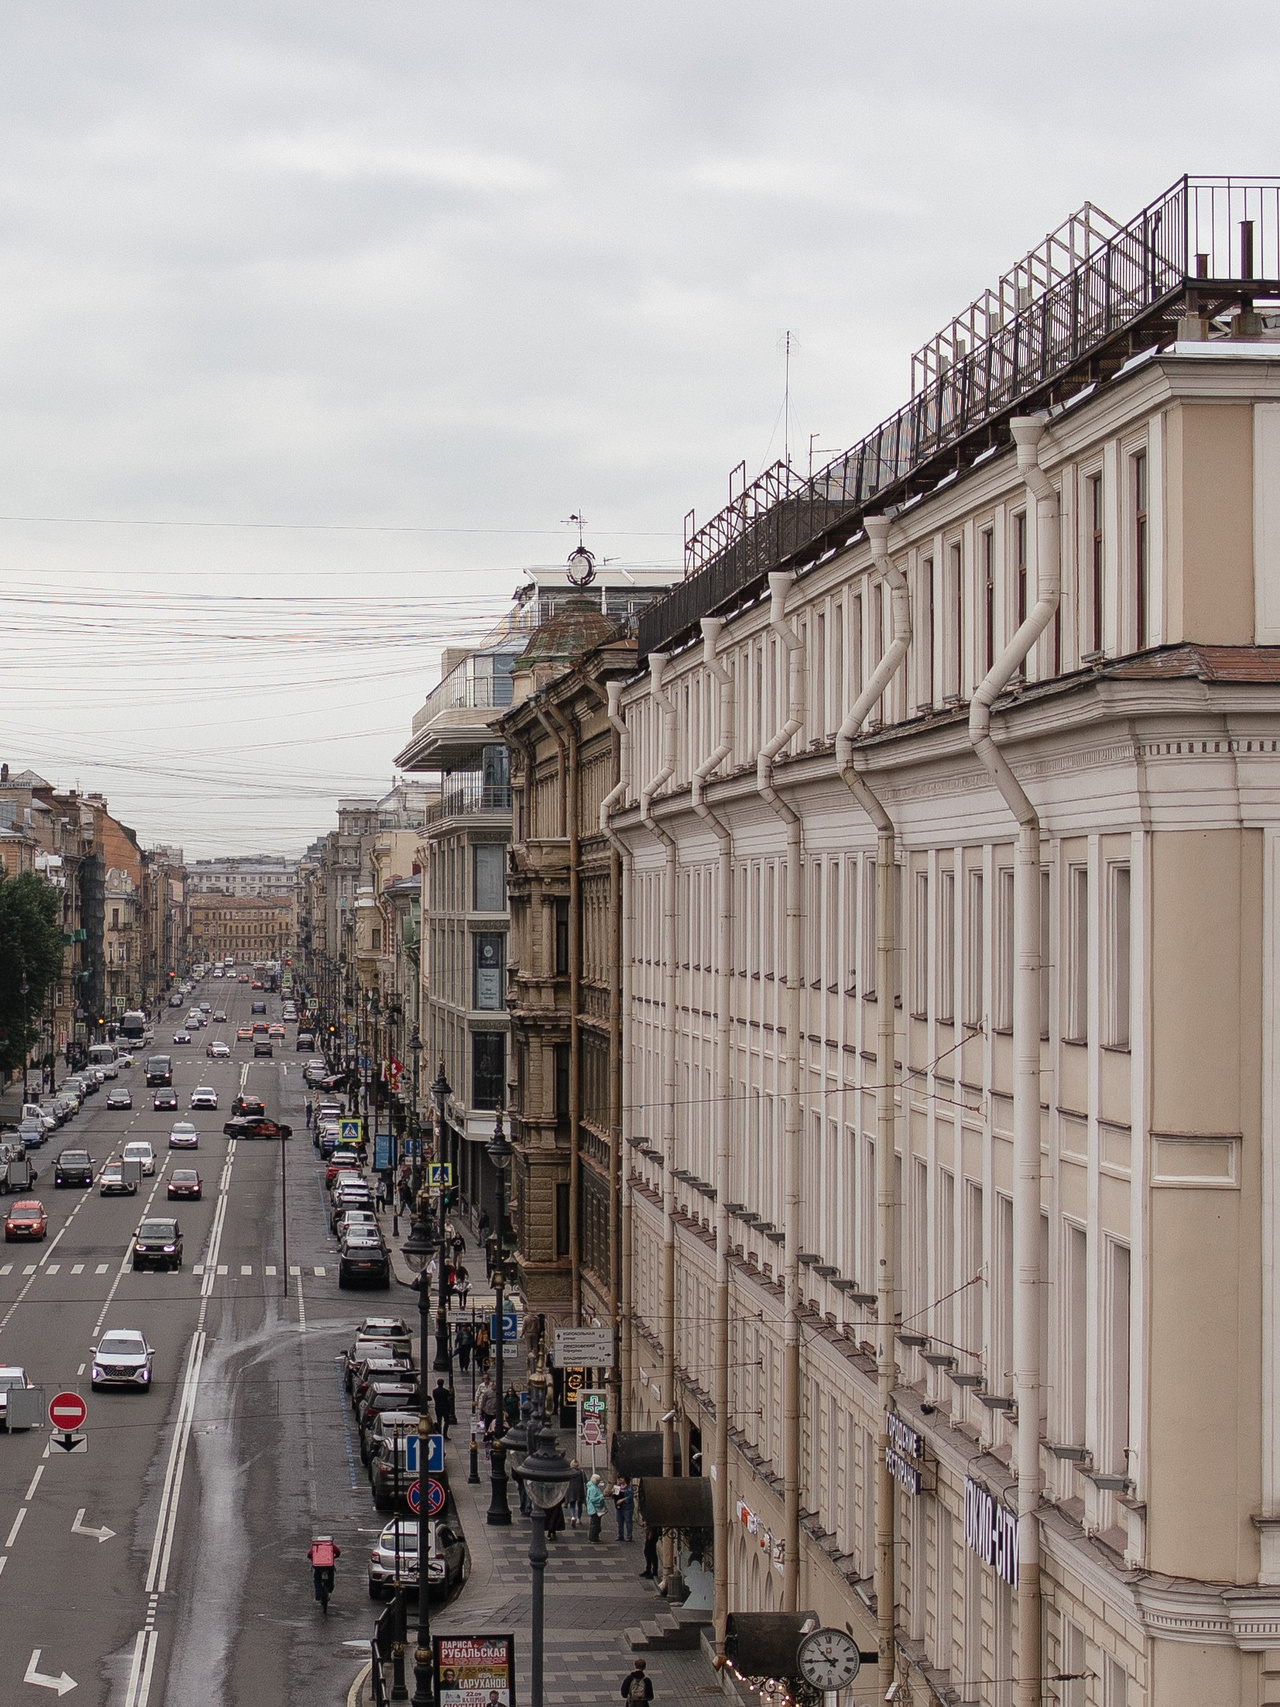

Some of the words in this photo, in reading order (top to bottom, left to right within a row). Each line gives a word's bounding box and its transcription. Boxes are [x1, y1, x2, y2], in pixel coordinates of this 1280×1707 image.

[886, 1446, 919, 1496] РЕСТОРАНЫ
[441, 1648, 507, 1658] РУБАЛЬСКАЯ
[458, 1678, 507, 1689] САРУХАНОВ
